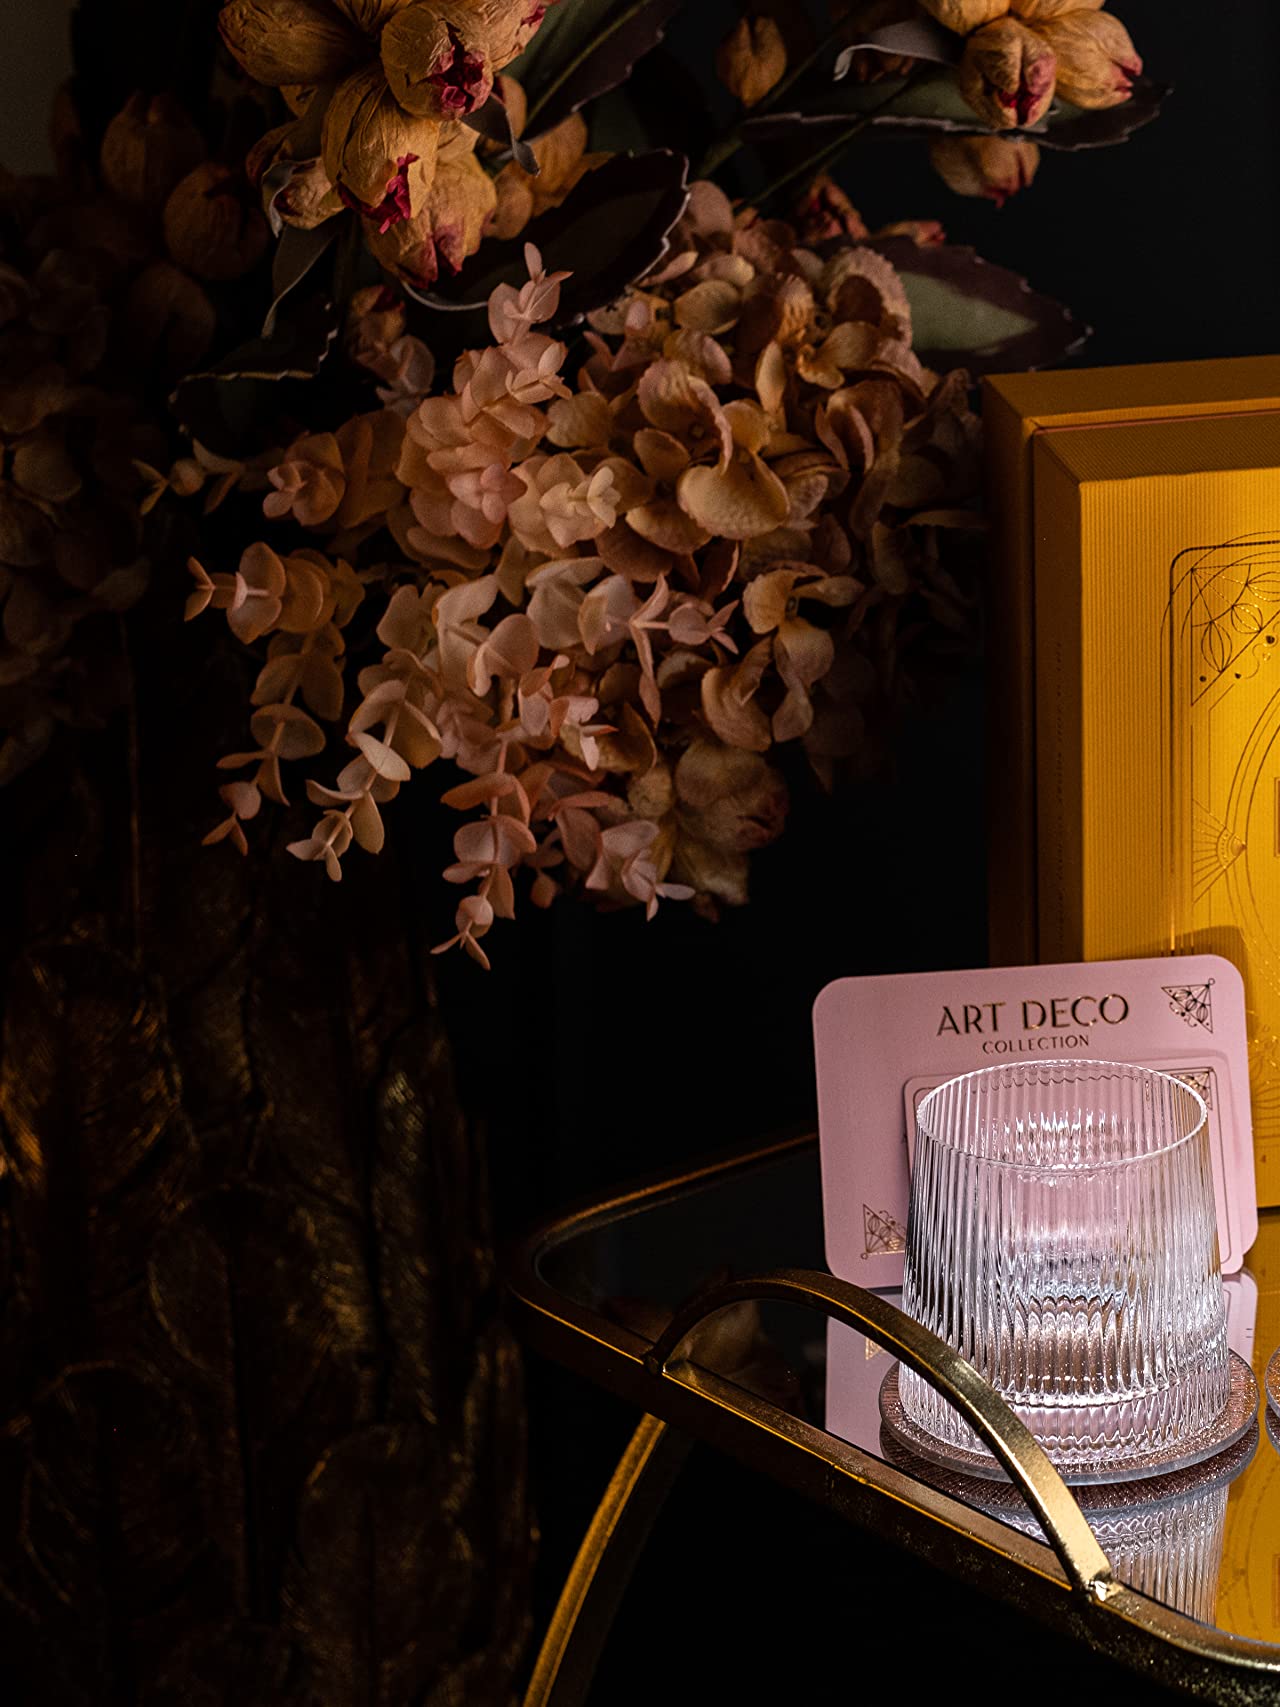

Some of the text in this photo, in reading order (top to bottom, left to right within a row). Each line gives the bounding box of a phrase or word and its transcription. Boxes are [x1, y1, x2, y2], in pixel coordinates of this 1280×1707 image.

[935, 993, 1130, 1037] ART DECO
[981, 1034, 1090, 1055] COLLECTION
